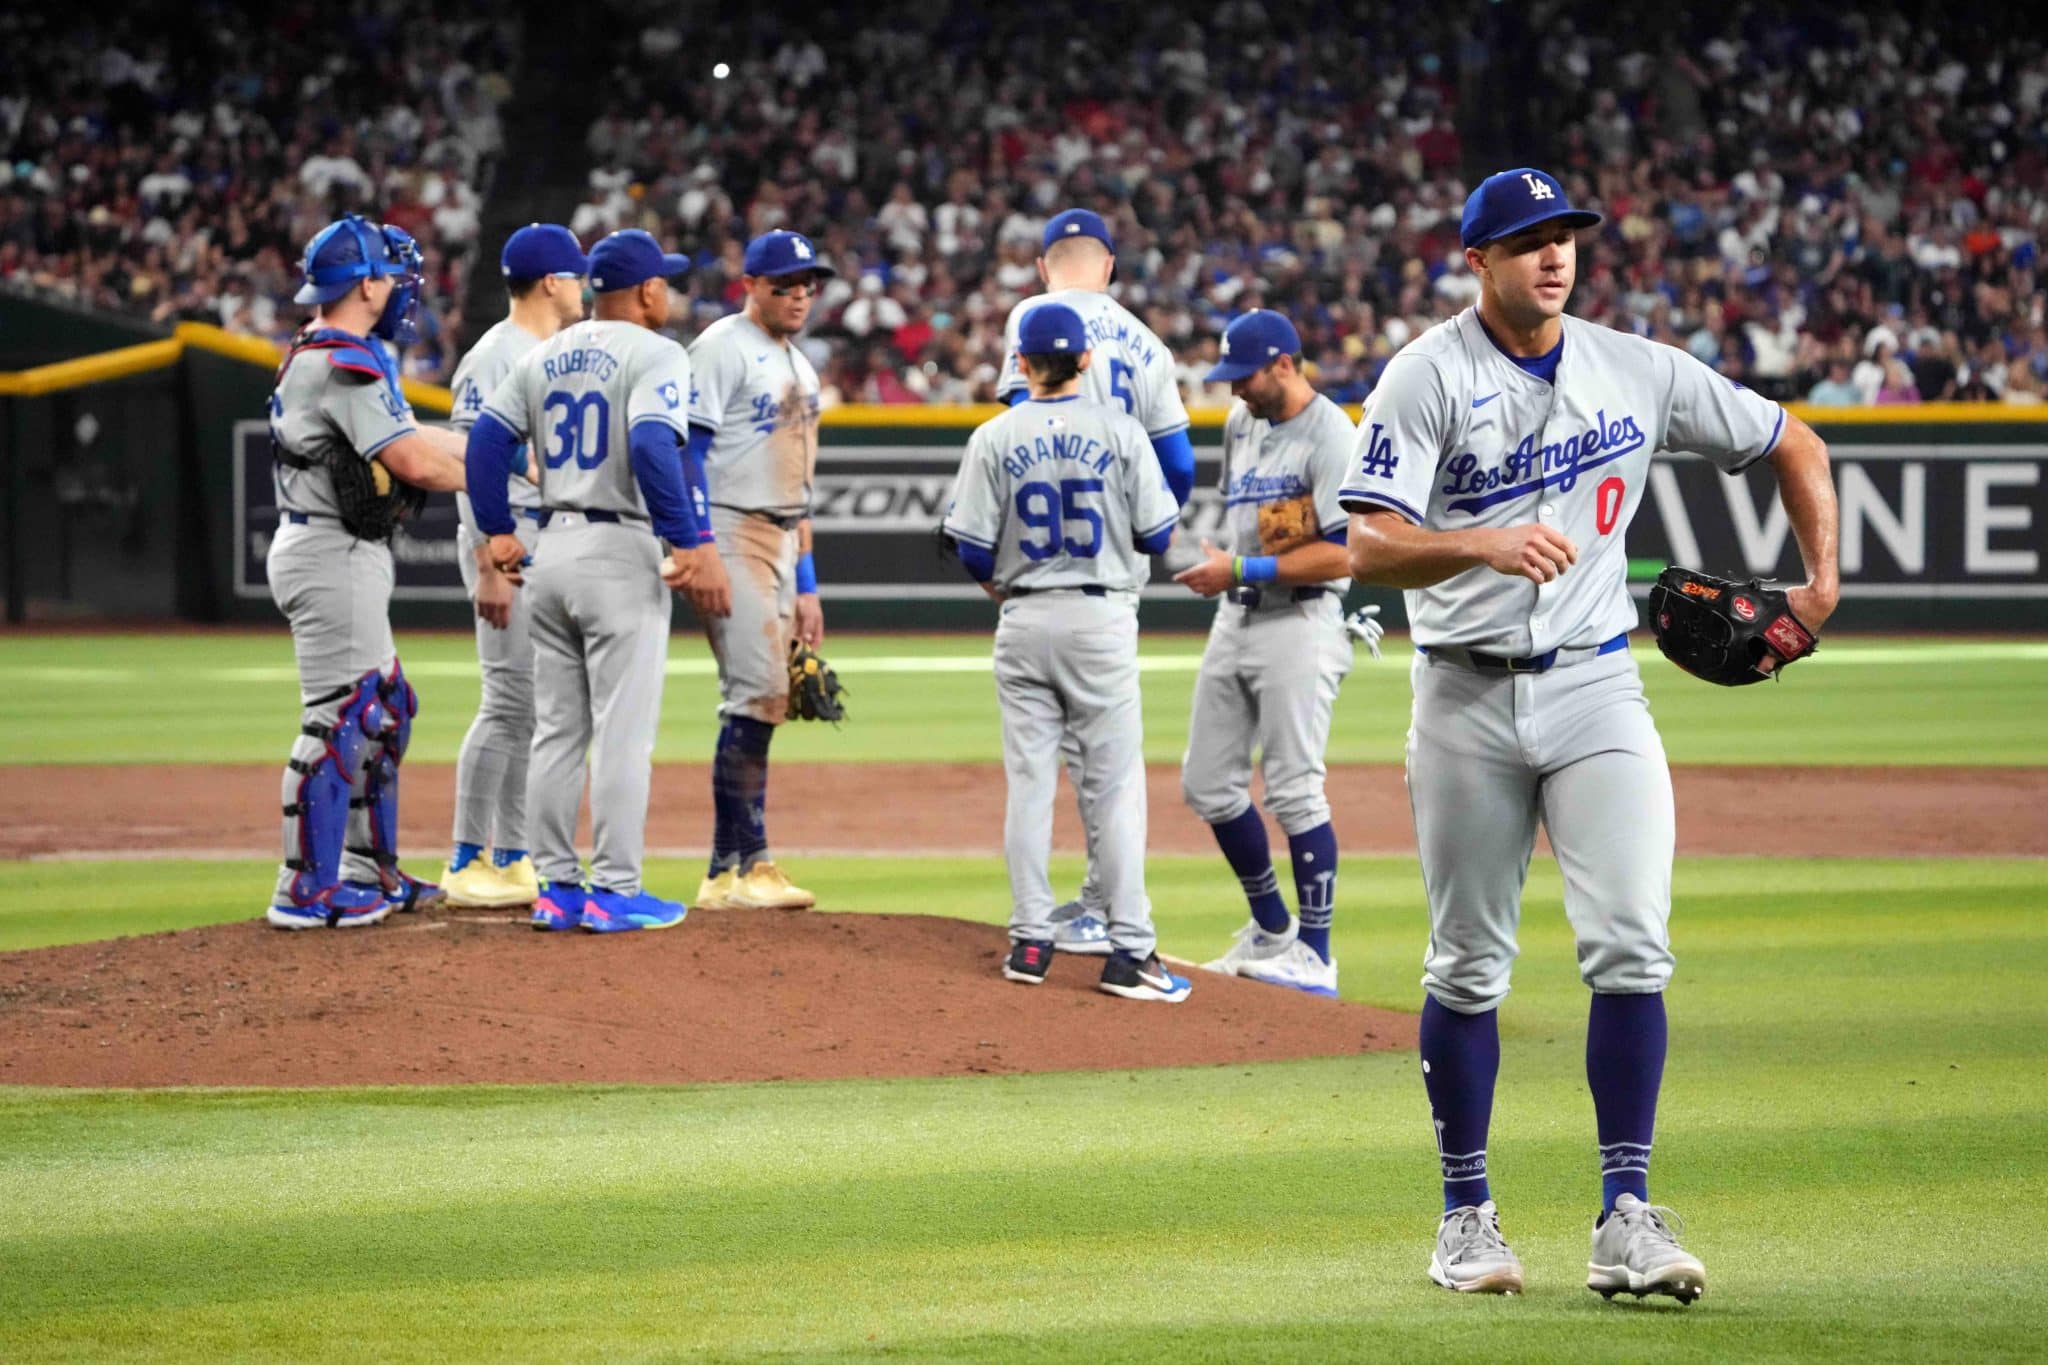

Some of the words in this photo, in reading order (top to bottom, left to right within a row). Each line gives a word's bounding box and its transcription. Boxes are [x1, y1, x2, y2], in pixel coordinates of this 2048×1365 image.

[1521, 173, 1556, 200] LA
[543, 348, 618, 383] ROBERTS
[1109, 357, 1134, 415] 5
[464, 377, 484, 412] LA
[543, 390, 610, 470] 30
[1002, 433, 1116, 480] BRANDEN
[1361, 423, 1399, 479] LA
[1442, 452, 1500, 495] Los
[1501, 408, 1645, 493] Angeles
[1015, 478, 1105, 561] 95
[1595, 476, 1626, 536] 0
